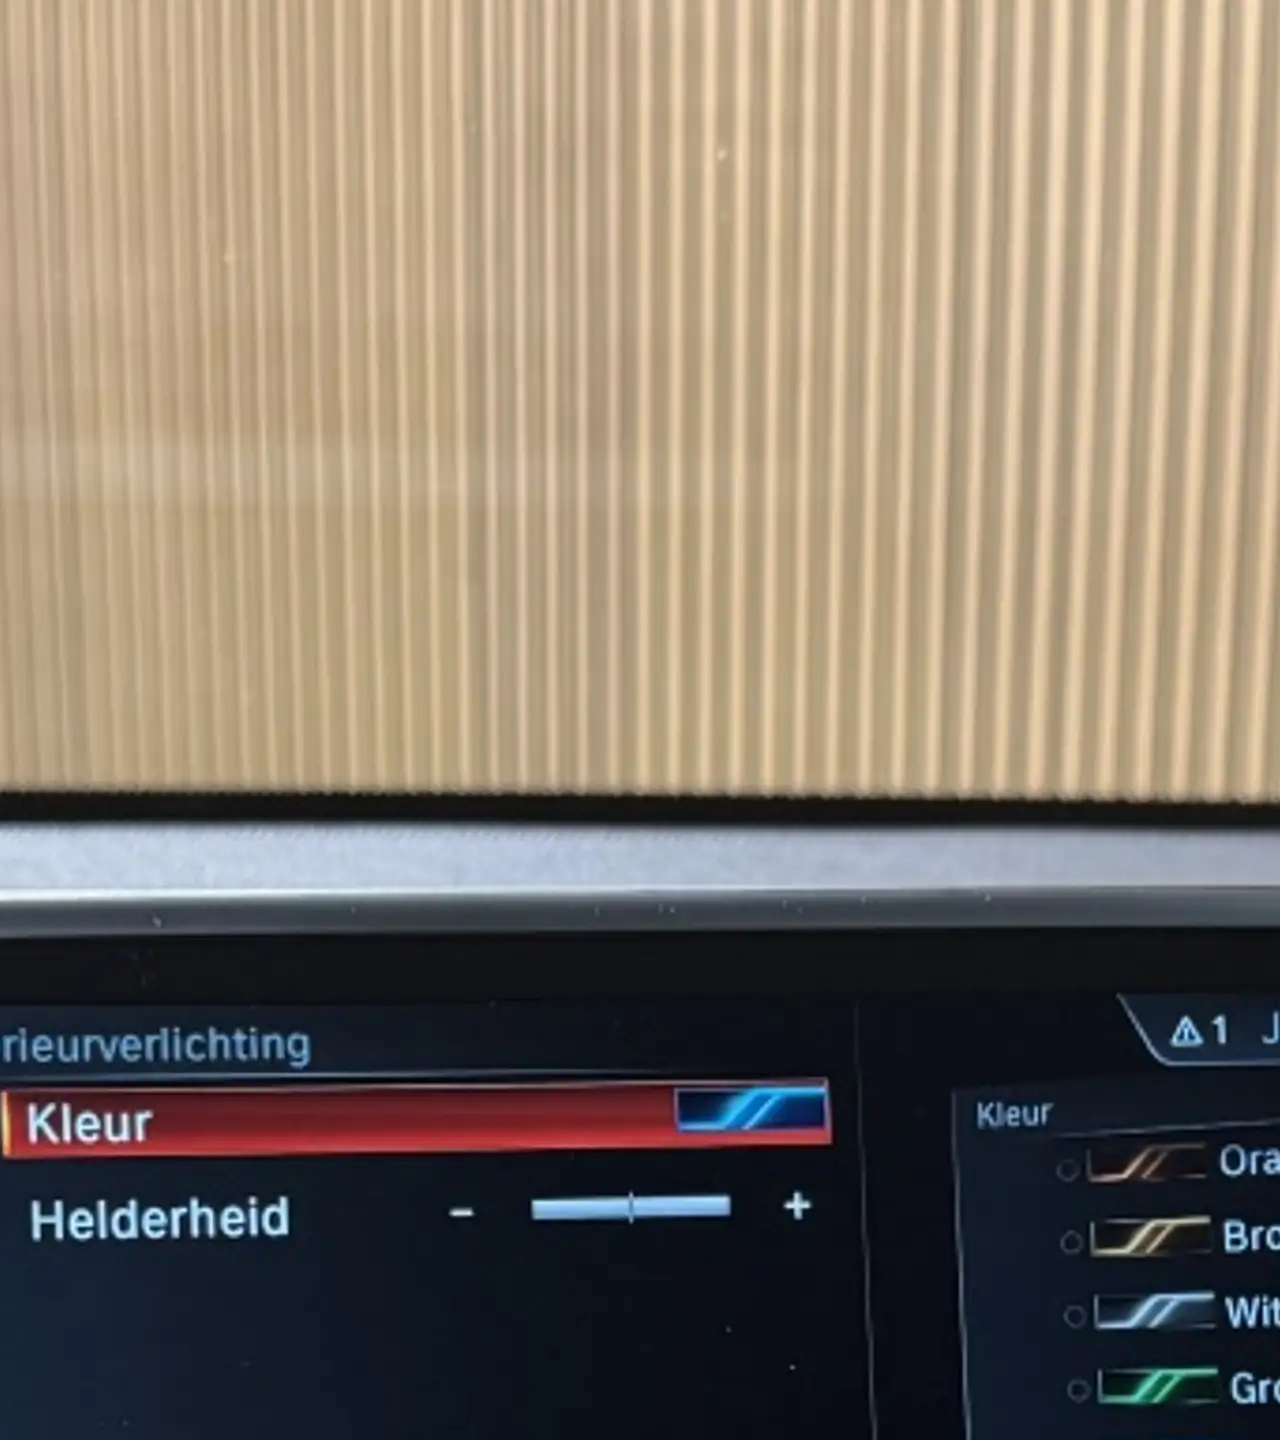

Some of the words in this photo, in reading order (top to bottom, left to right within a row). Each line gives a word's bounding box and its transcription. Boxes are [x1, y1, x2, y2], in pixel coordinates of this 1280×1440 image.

[1210, 1014, 1228, 1046] 1
[26, 1101, 154, 1146] Kleur
[976, 1099, 1054, 1129] Kleur
[29, 1194, 291, 1243] Helderheid
